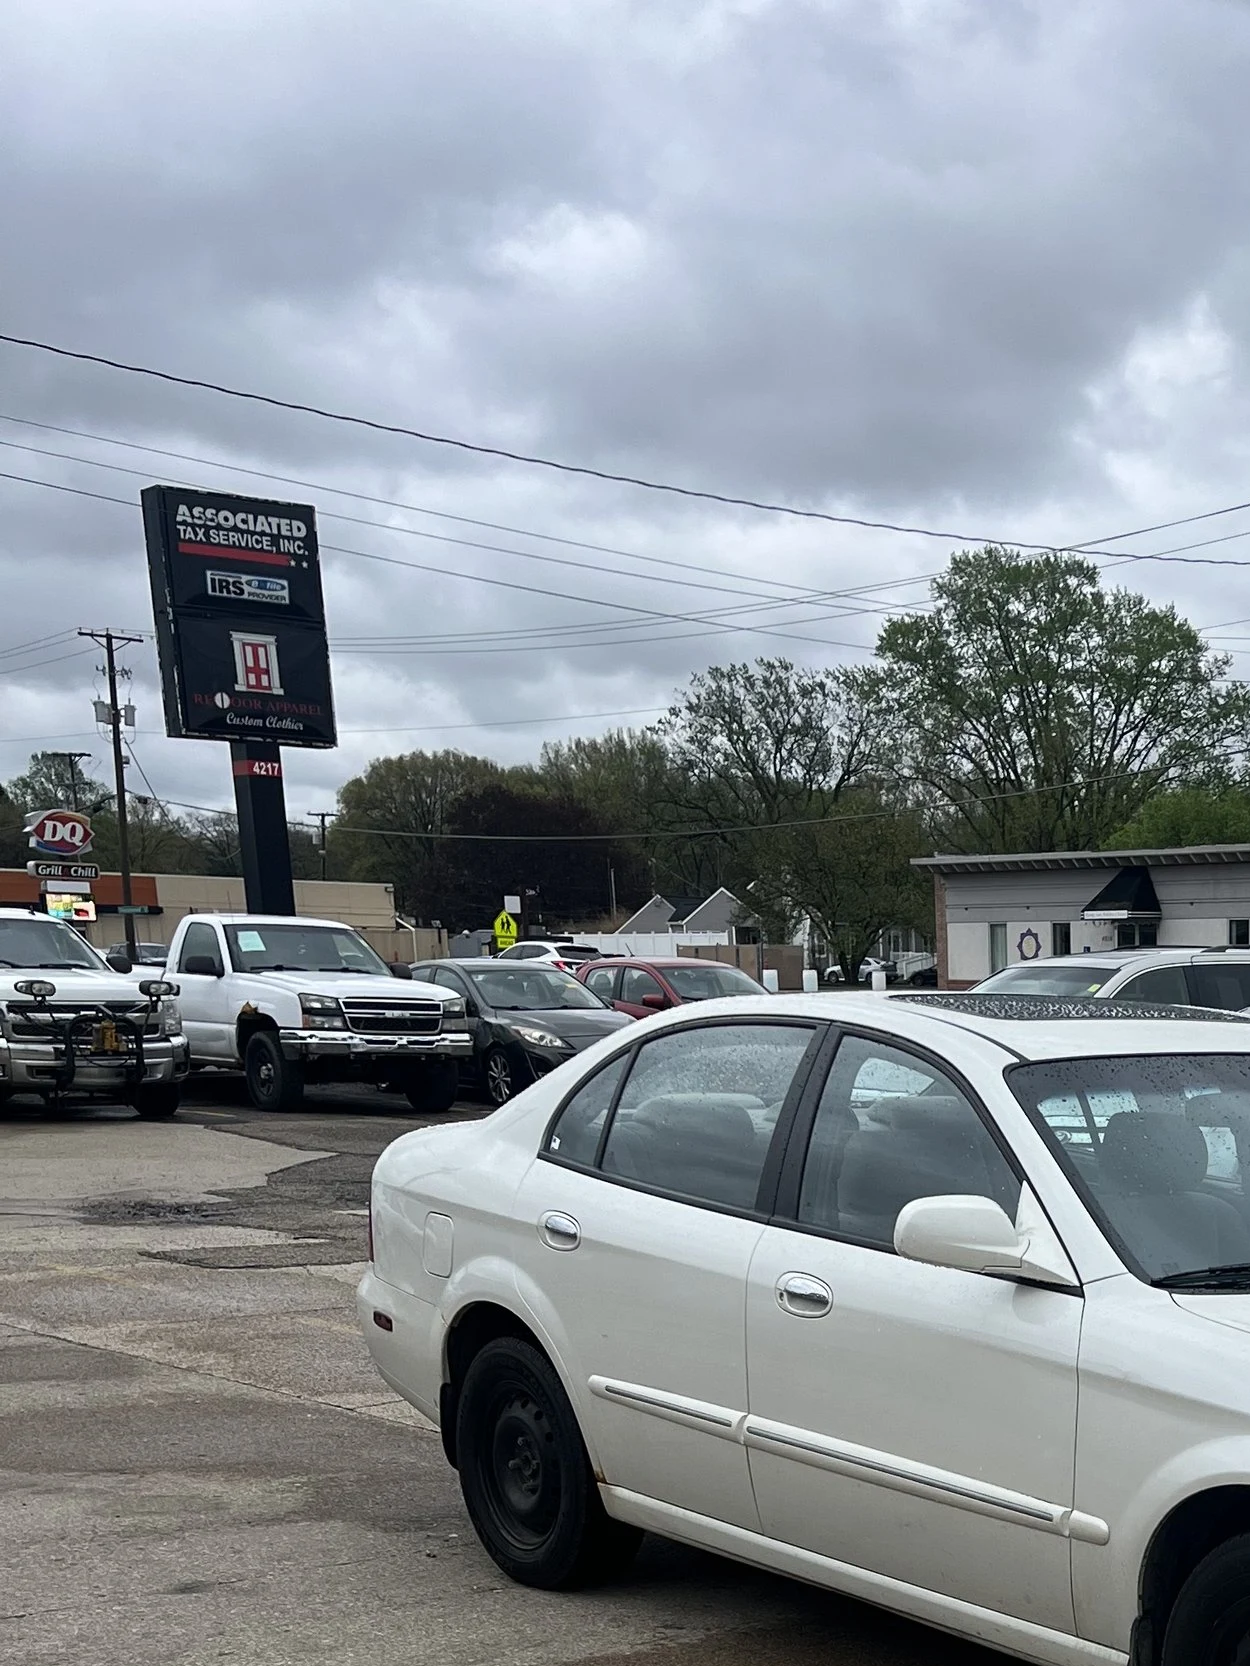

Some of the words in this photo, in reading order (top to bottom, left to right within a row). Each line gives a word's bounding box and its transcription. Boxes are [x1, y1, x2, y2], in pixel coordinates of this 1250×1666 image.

[176, 504, 307, 538] ASSOCIATED
[176, 525, 206, 542] TAX
[209, 529, 276, 553] SERVICE,
[279, 538, 309, 555] INC.
[210, 577, 245, 597] IRS
[247, 591, 287, 602] PROVIDER
[266, 700, 324, 716] APPAREL
[226, 712, 263, 727] Custom
[265, 715, 304, 731] Clothier
[252, 761, 280, 776] 4217
[42, 820, 85, 846] DQ
[38, 864, 62, 876] Grill
[70, 866, 96, 878] Chill
